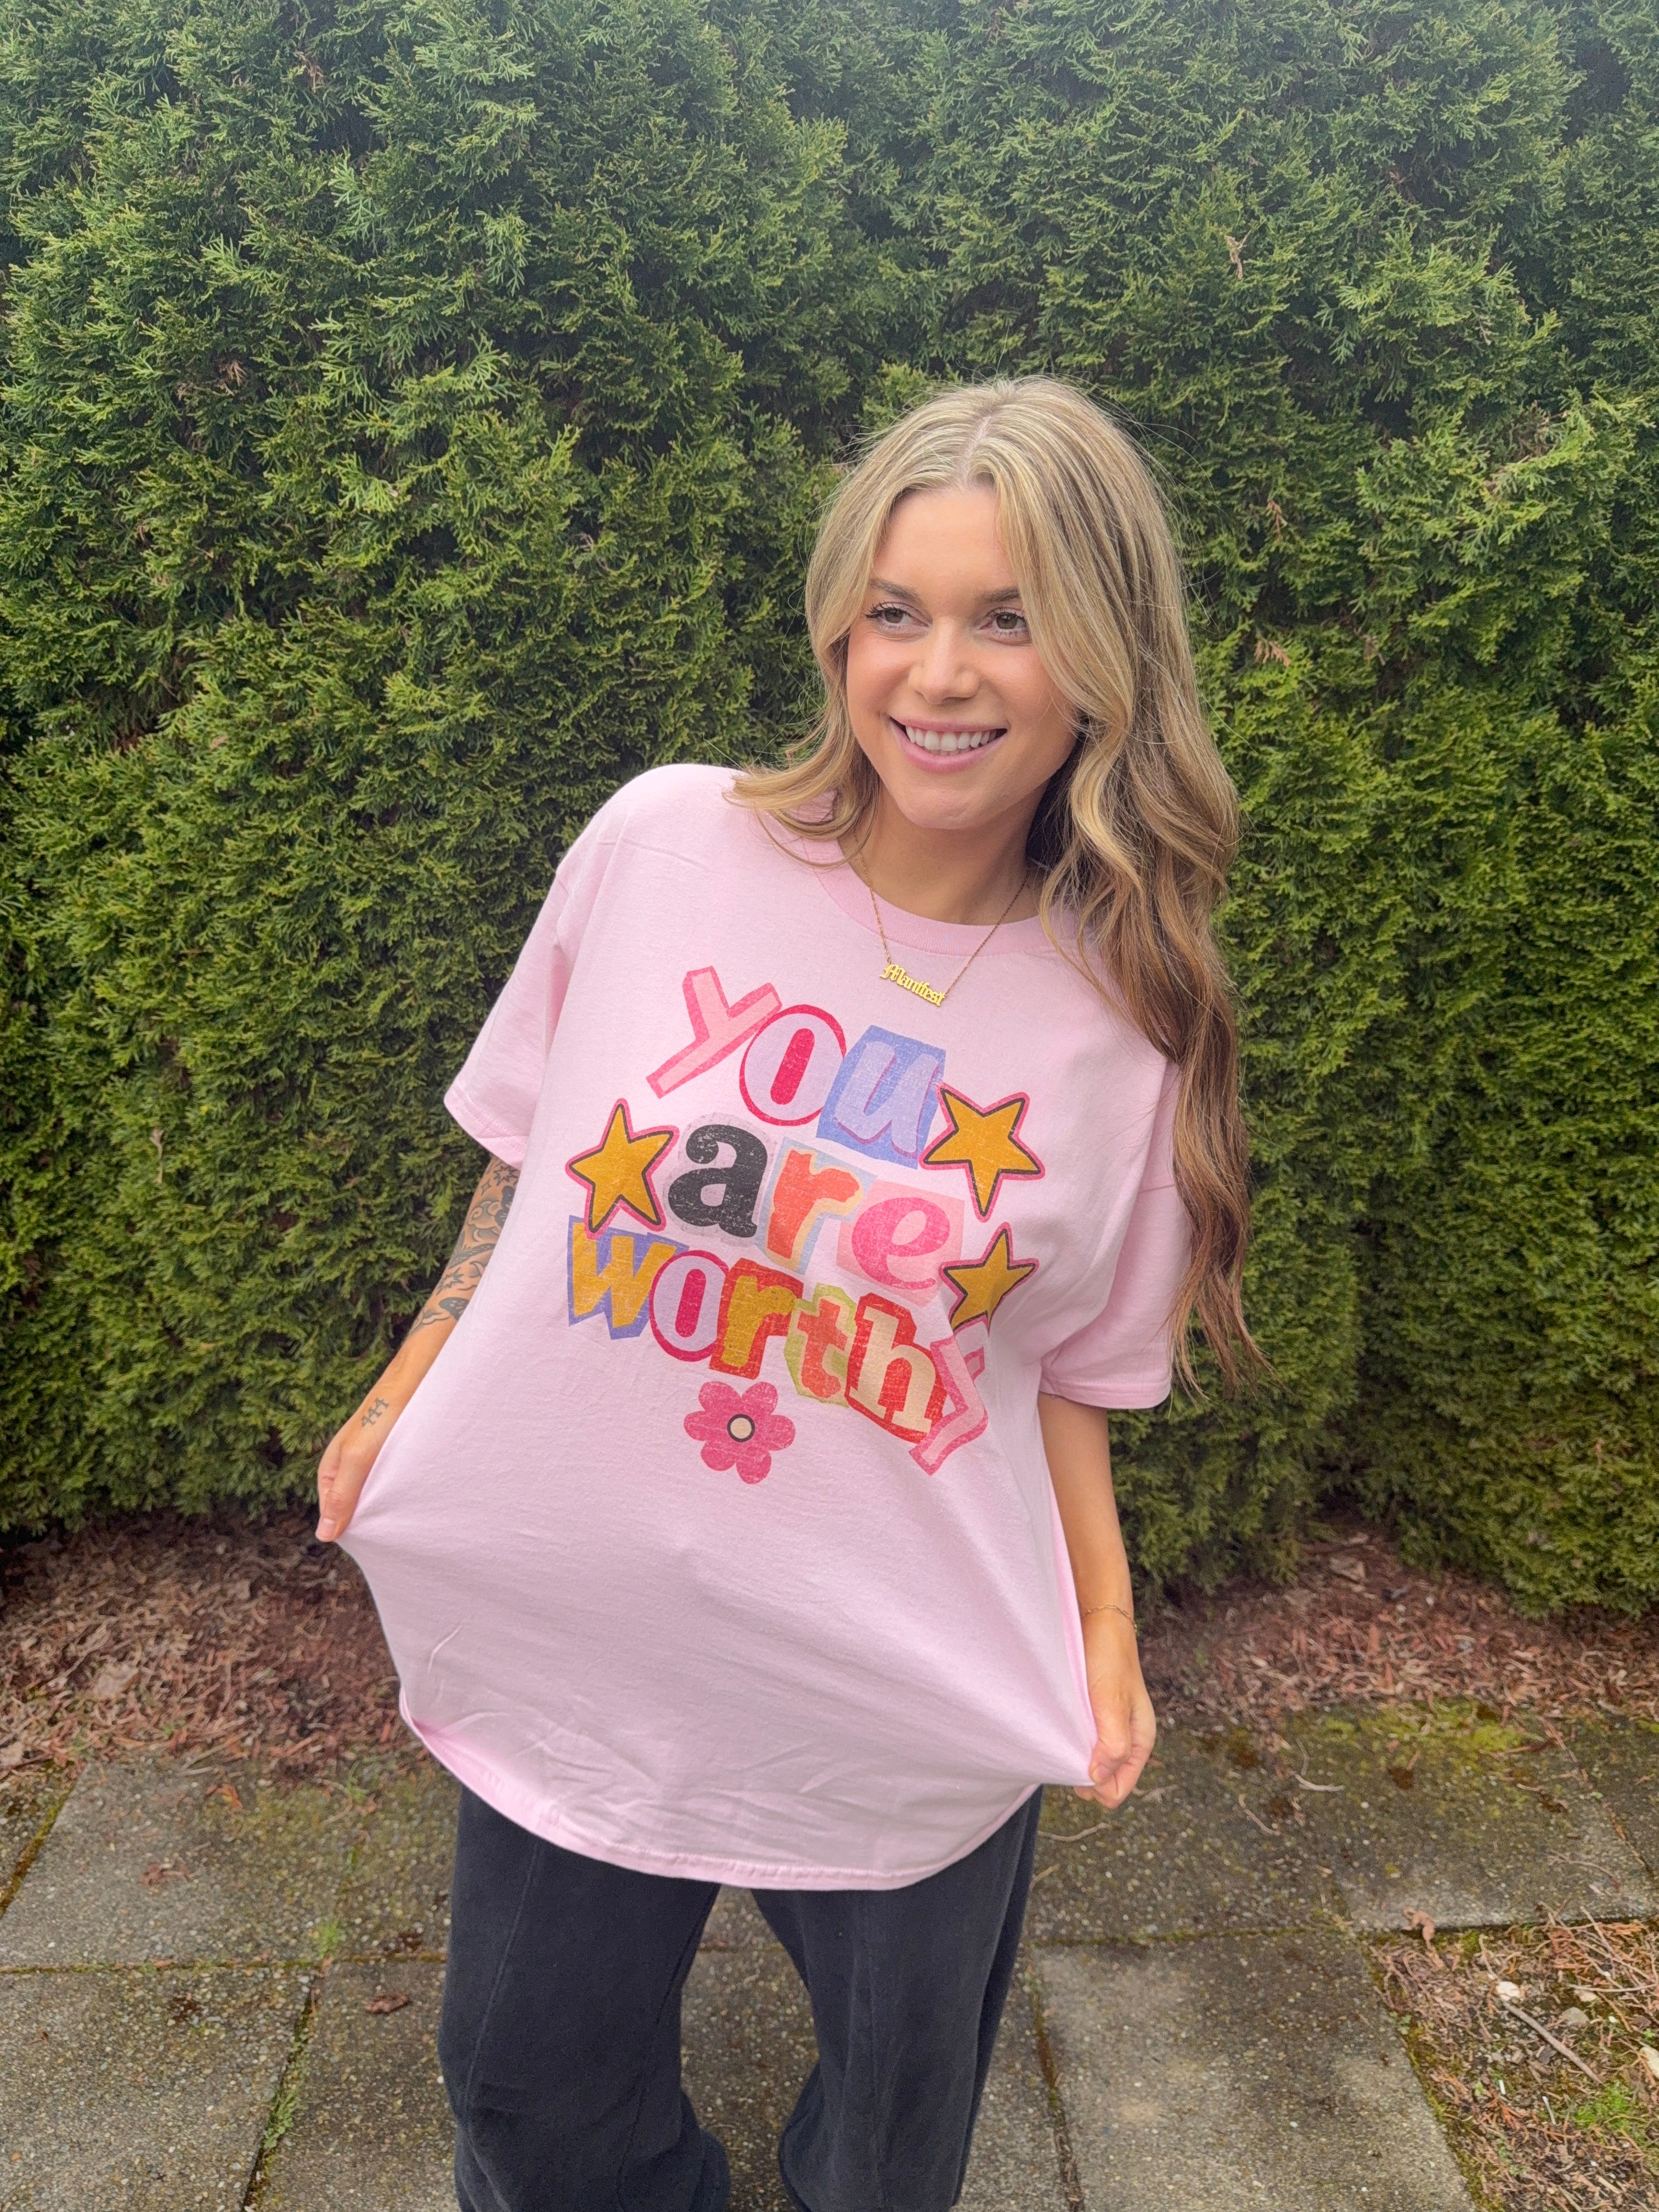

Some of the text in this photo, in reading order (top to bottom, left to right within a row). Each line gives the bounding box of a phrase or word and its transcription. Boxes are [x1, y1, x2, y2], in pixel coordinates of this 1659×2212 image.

[879, 964, 945, 1006] Manifest
[668, 1123, 952, 1290] are
[362, 1397, 389, 1427] 444
